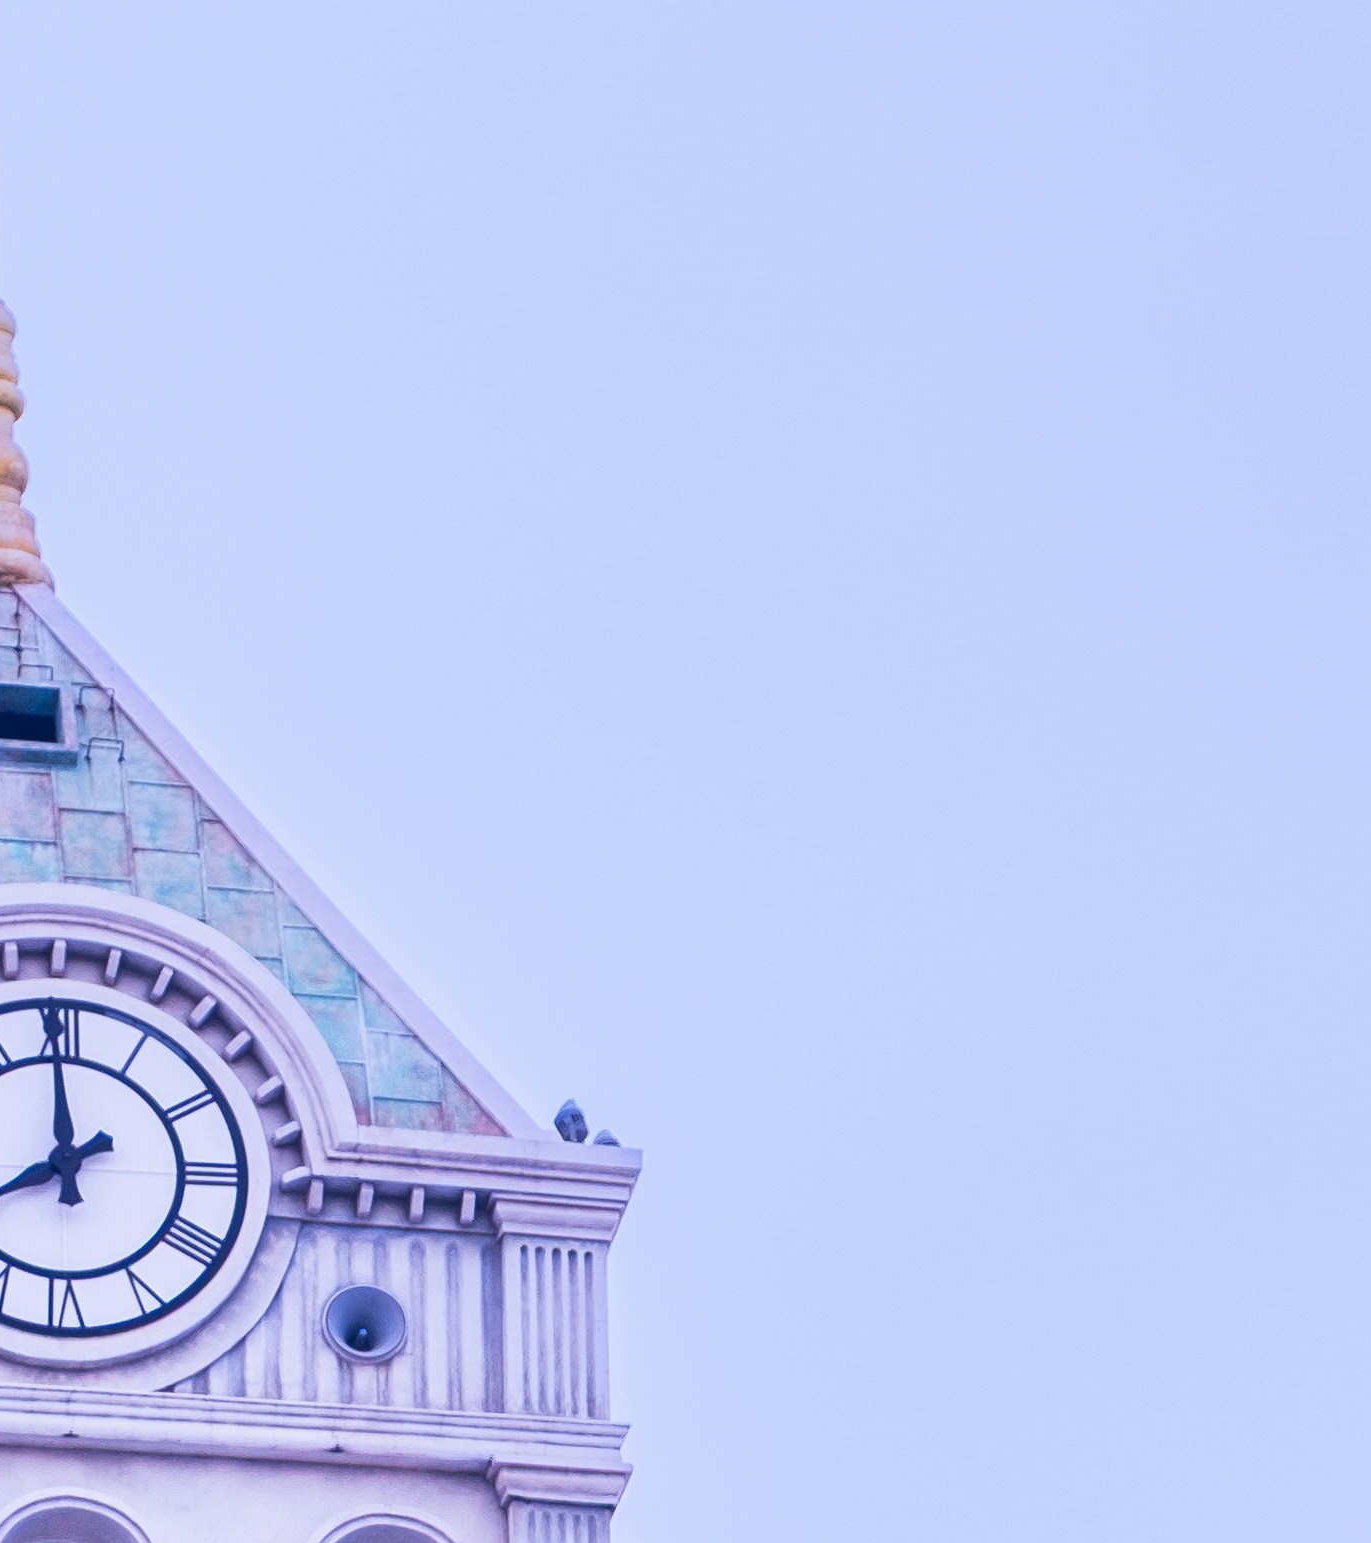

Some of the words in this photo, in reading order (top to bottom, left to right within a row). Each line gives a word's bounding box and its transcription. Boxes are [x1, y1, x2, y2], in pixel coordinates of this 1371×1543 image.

[119, 1033, 150, 1076] I
[163, 1088, 217, 1123] II
[184, 1161, 238, 1187] III
[161, 1214, 223, 1266] IIII
[47, 1277, 86, 1329] VI
[125, 1268, 168, 1316] V
